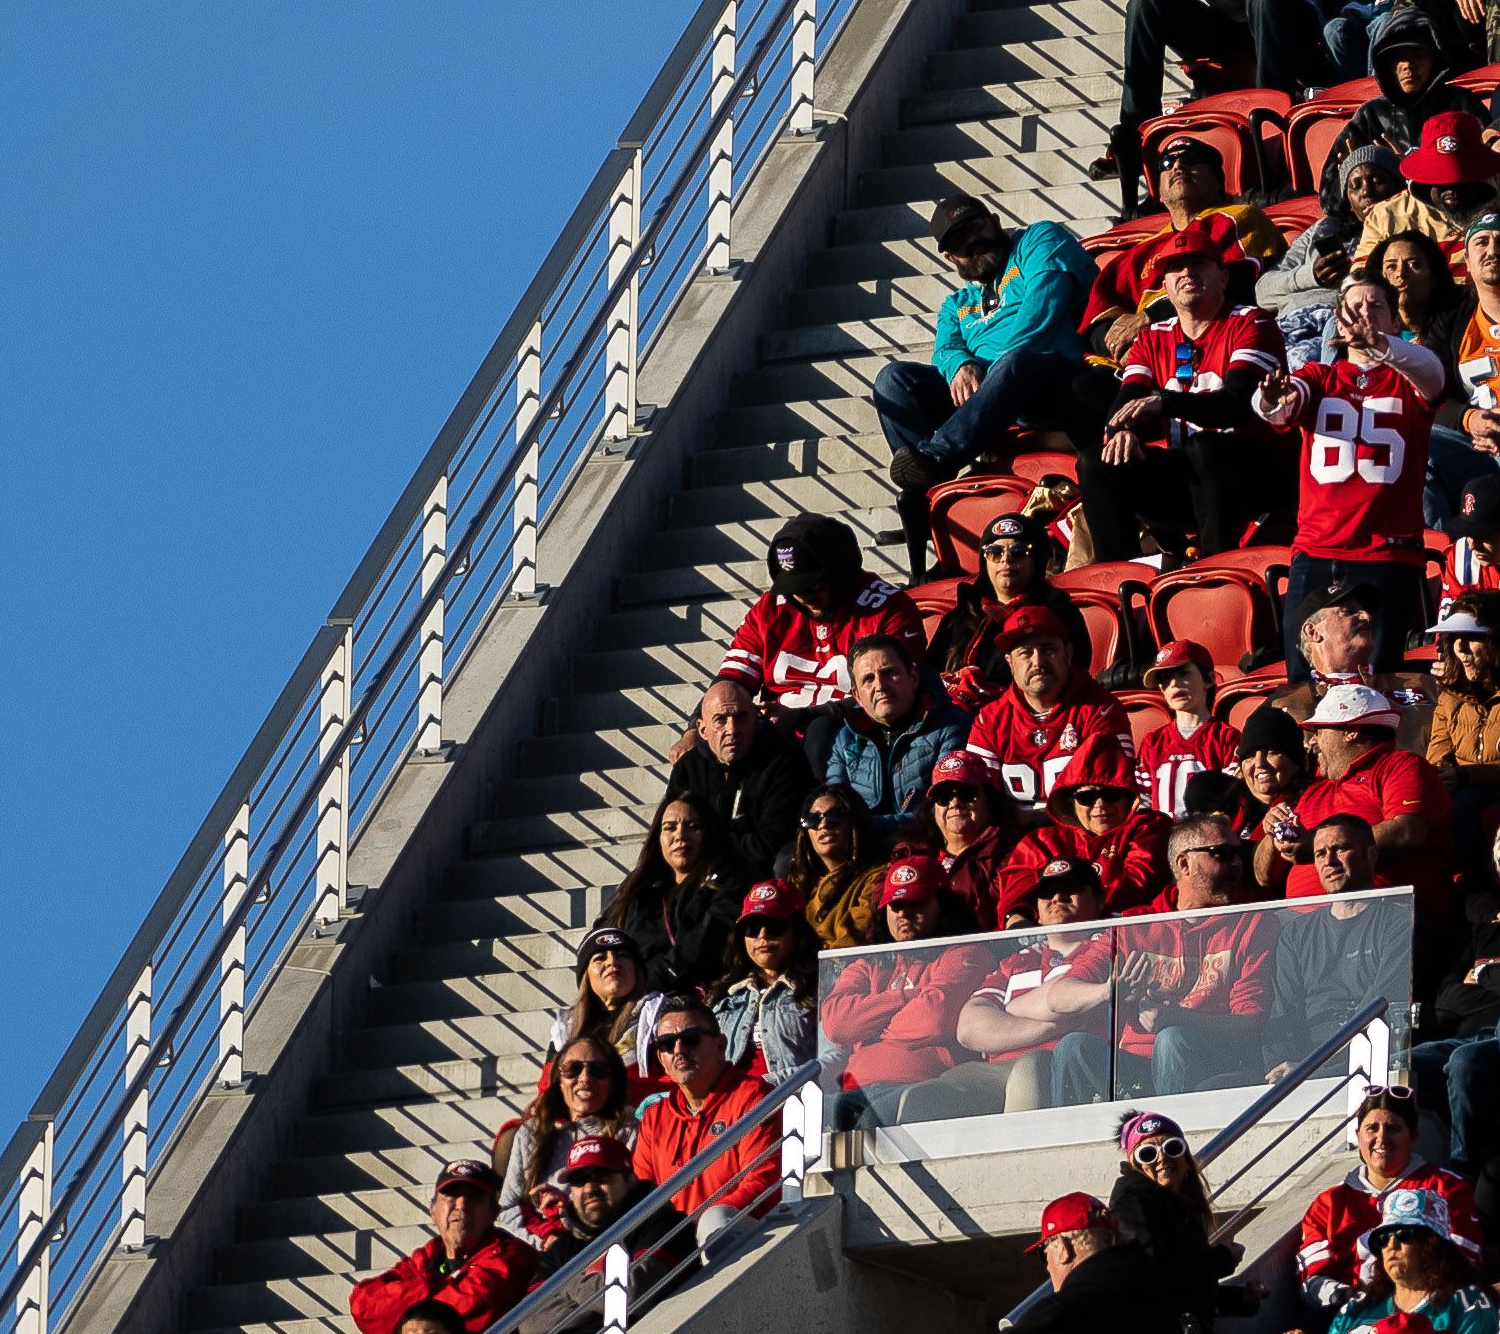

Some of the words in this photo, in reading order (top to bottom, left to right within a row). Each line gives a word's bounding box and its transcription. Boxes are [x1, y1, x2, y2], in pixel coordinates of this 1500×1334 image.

[1307, 397, 1405, 485] 85
[855, 578, 898, 610] 52
[773, 649, 854, 709] 52
